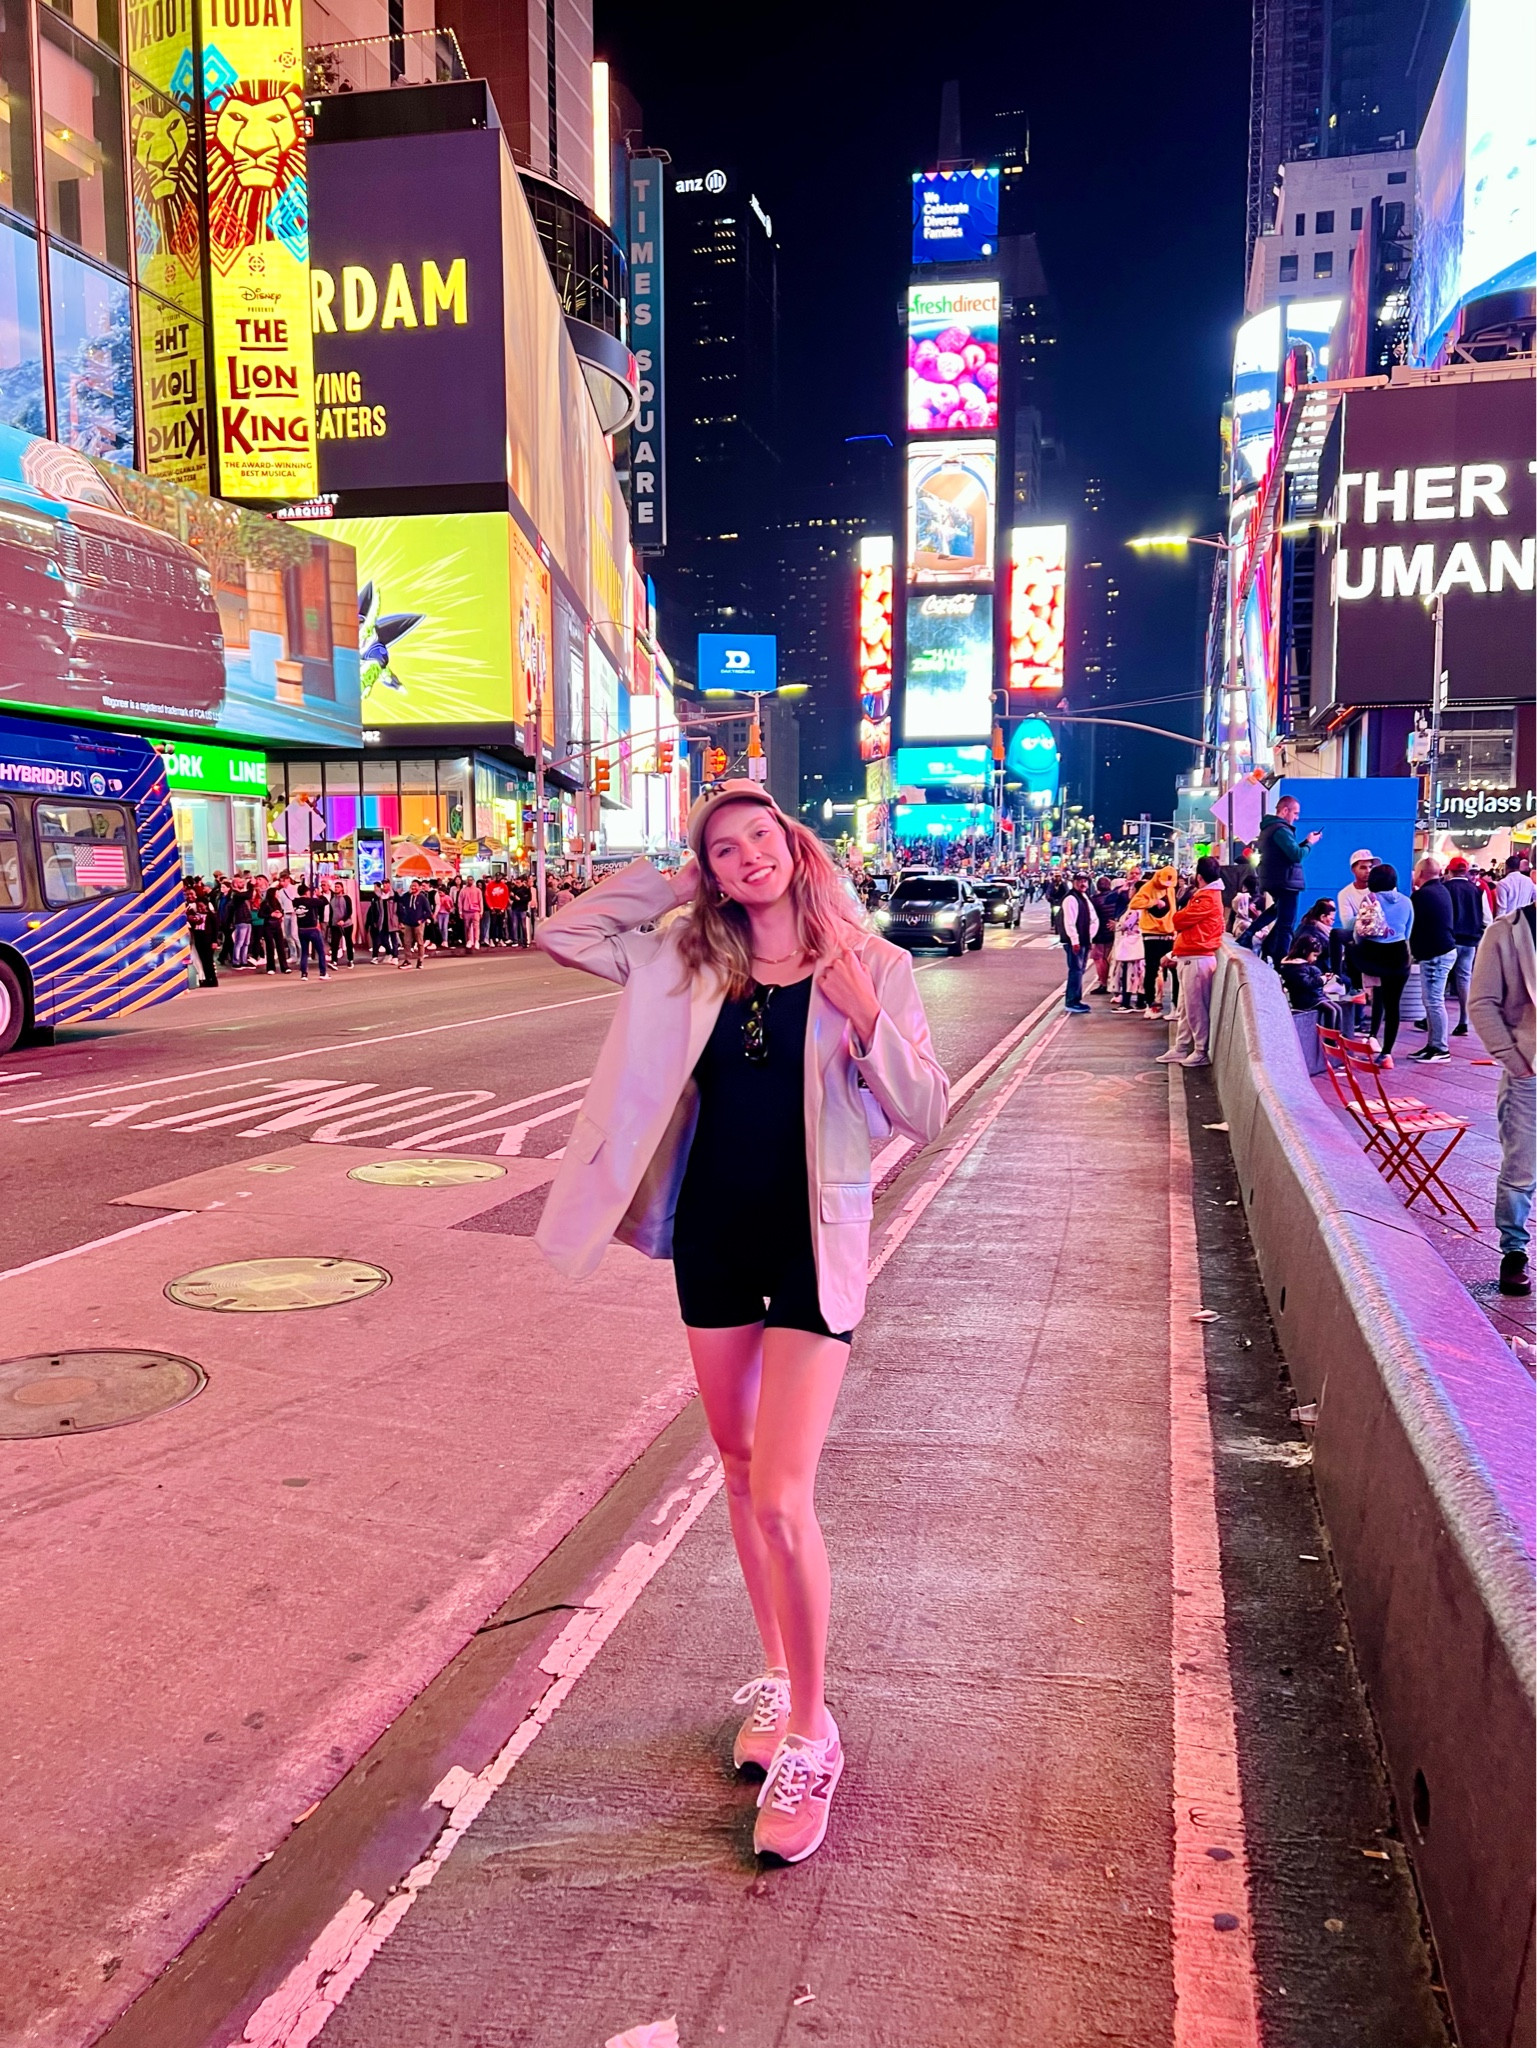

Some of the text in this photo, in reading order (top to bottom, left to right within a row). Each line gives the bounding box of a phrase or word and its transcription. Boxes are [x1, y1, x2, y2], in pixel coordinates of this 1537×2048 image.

[675, 178, 704, 193] anz
[923, 192, 940, 203] We
[923, 203, 970, 215] Celebrate
[923, 215, 959, 227] Diverse
[923, 226, 963, 240] Families
[238, 286, 281, 304] Disney
[310, 258, 468, 334] RDAM
[909, 294, 998, 314] freshdirect
[235, 319, 288, 343] THE
[631, 179, 656, 524] TIMES SQUARE
[227, 356, 299, 399] LION
[315, 371, 361, 404] YING
[222, 406, 310, 455] KING
[1339, 464, 1508, 524] THER
[278, 506, 332, 518] MARQUIS
[229, 759, 266, 784] LINE
